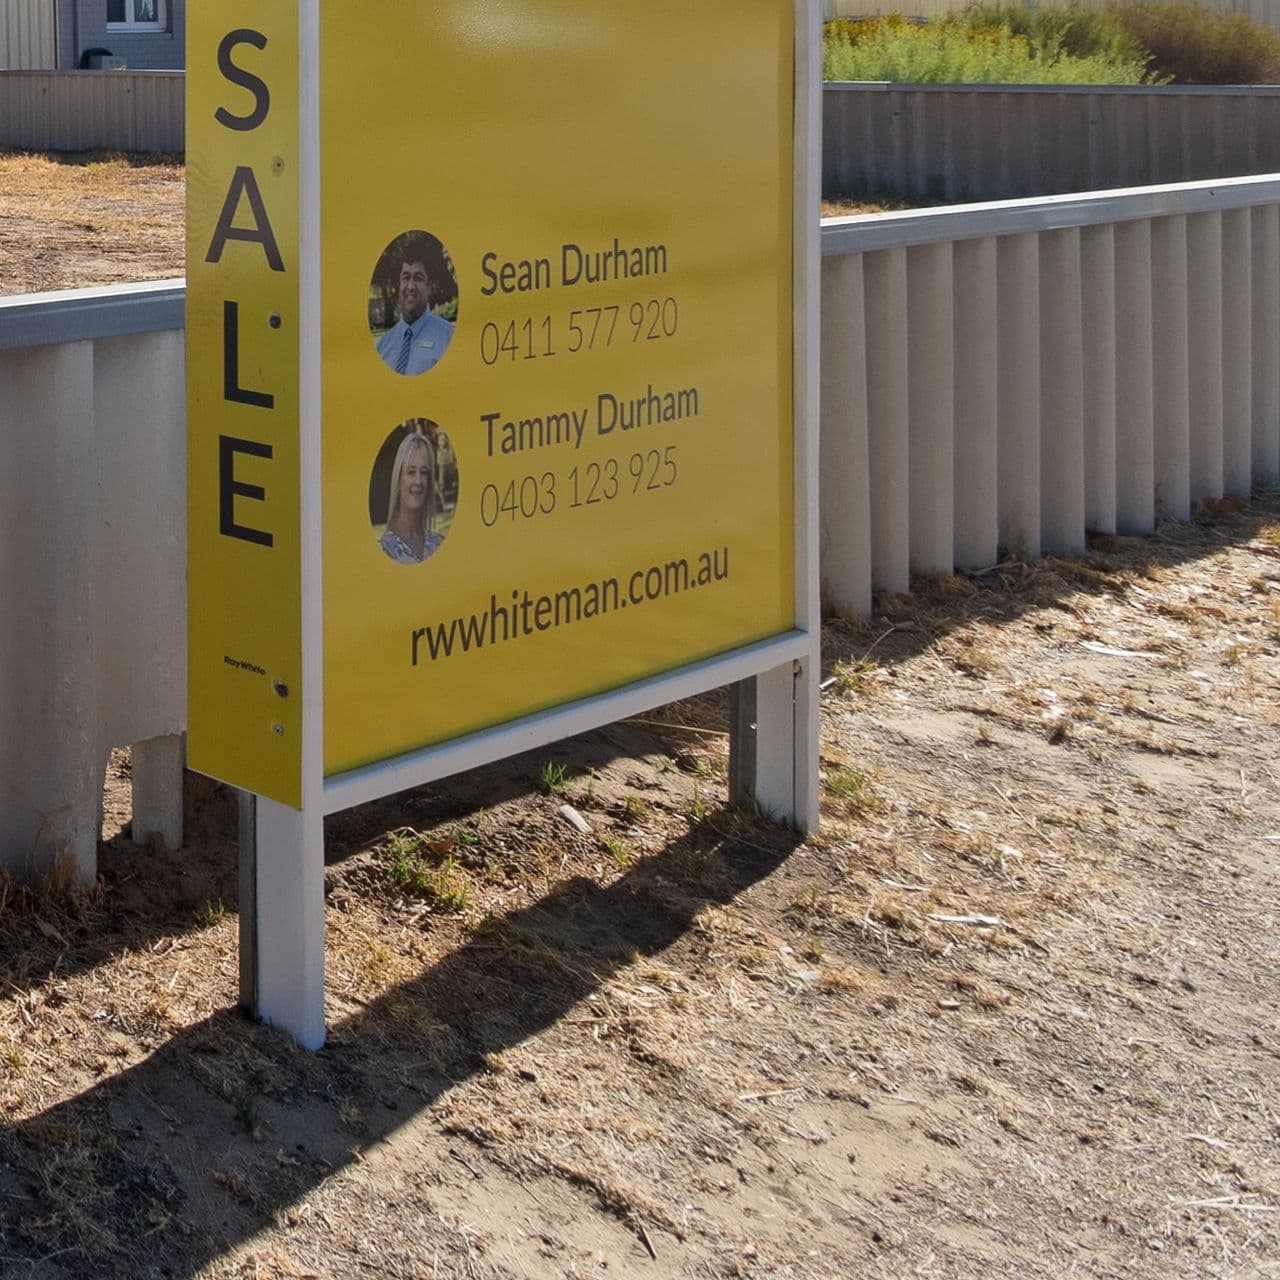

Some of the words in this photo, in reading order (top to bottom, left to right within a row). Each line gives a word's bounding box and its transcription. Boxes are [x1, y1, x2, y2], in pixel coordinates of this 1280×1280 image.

[204, 28, 286, 548] SALE
[481, 252, 551, 296] Sean
[562, 238, 668, 286] Durham
[481, 314, 556, 365] 0411
[568, 306, 619, 352] 577
[629, 297, 678, 342] 920
[480, 408, 588, 457] Tammy
[597, 384, 699, 436] Durham
[480, 472, 556, 527] 0403
[568, 458, 619, 508] 123
[629, 445, 677, 494] 925
[410, 546, 729, 666] rwwhiteman.com.au
